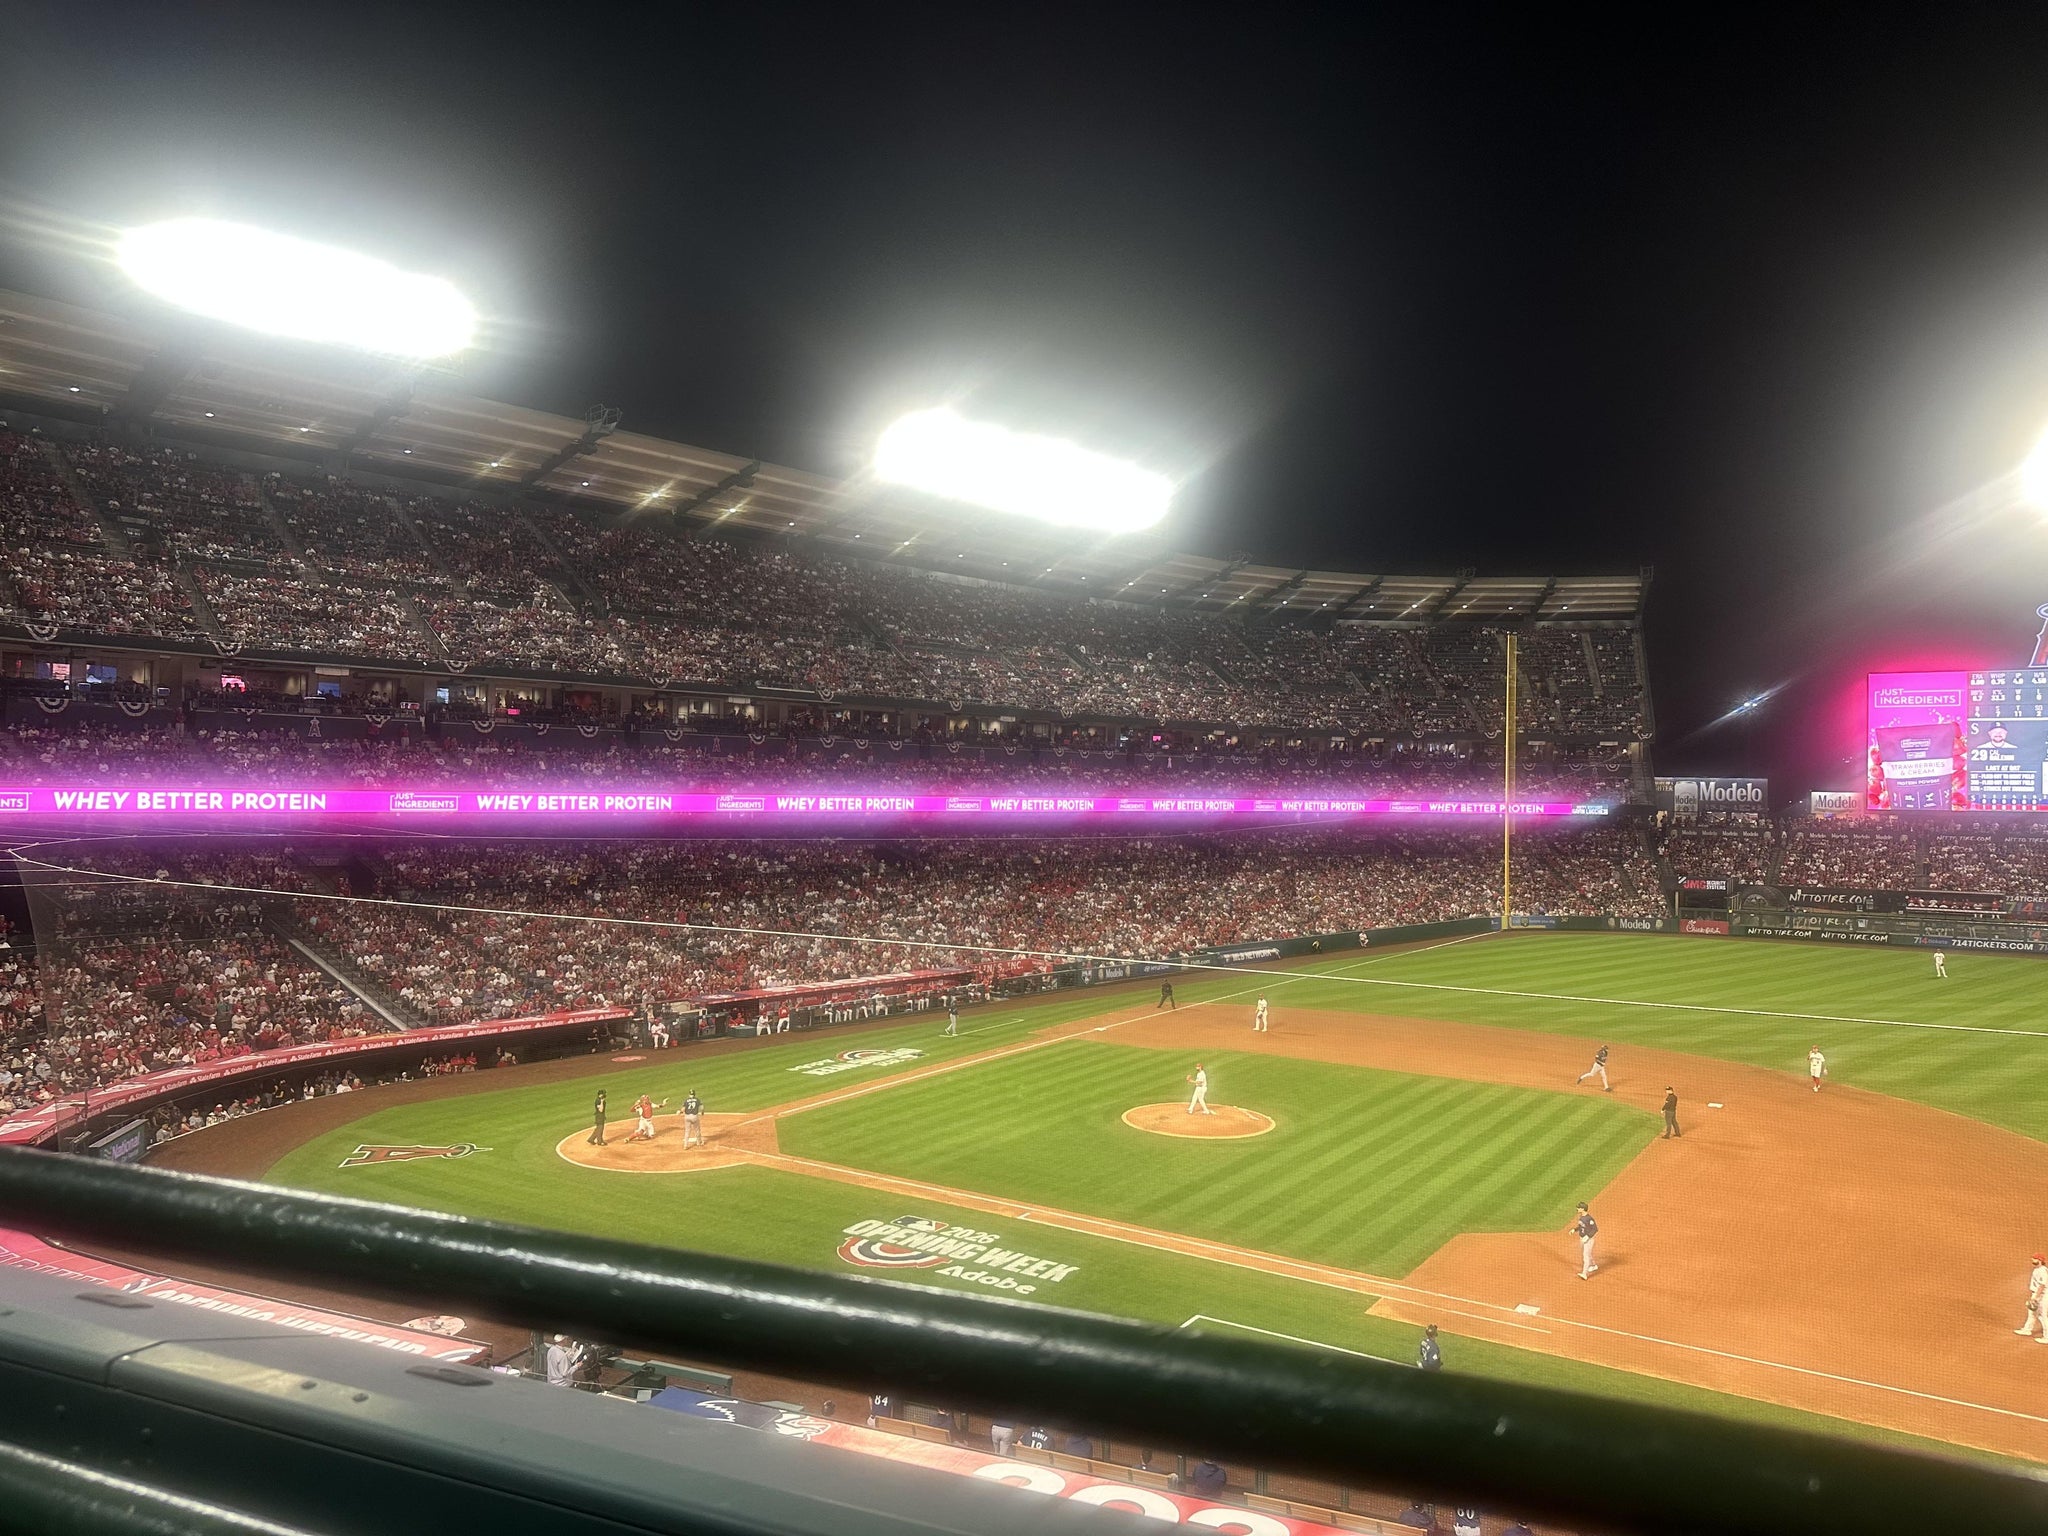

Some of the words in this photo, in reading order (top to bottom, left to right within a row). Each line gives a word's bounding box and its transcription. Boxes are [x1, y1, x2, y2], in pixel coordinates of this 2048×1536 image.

[1880, 696, 1956, 705] INGREDIENTS
[1971, 749, 1988, 761] 29
[1892, 762, 1945, 770] STRAWBERRIES
[1700, 781, 1762, 802] Modelo
[54, 792, 129, 809] WHEY
[137, 792, 223, 809] BETTER
[232, 793, 325, 809] PROTEIN
[477, 795, 532, 810] WHEY
[538, 796, 598, 810] BETTER
[605, 796, 671, 810] PROTEIN
[777, 797, 815, 810] WHEY
[819, 798, 862, 810] BETTER
[866, 798, 914, 810] PROTEIN
[991, 799, 1019, 810] WHEY
[1022, 800, 1054, 810] BETTER
[1057, 800, 1093, 810] PROTEIN
[1153, 800, 1175, 811] WHEY
[1177, 800, 1203, 811] BETTER
[1205, 800, 1234, 811] PROTEIN
[1282, 801, 1303, 811] WHEY
[1304, 801, 1329, 811] BETTER
[1331, 801, 1365, 811] PROTEIN
[1818, 795, 1857, 808] Modelo
[1430, 803, 1458, 812] WHEY
[1461, 803, 1496, 813] BETTER
[1684, 880, 1706, 889] JMG
[1620, 919, 1650, 929] Modelo
[1849, 933, 1888, 942] TIRE.COM
[1952, 939, 2033, 950] 714TICKETS.COM
[1106, 968, 1123, 978] Modelo
[938, 1226, 1000, 1244] 2026
[842, 1219, 987, 1260] OPENING
[974, 1246, 1080, 1282] WEEK
[935, 1266, 1037, 1294] Adobe
[874, 1394, 888, 1406] 84
